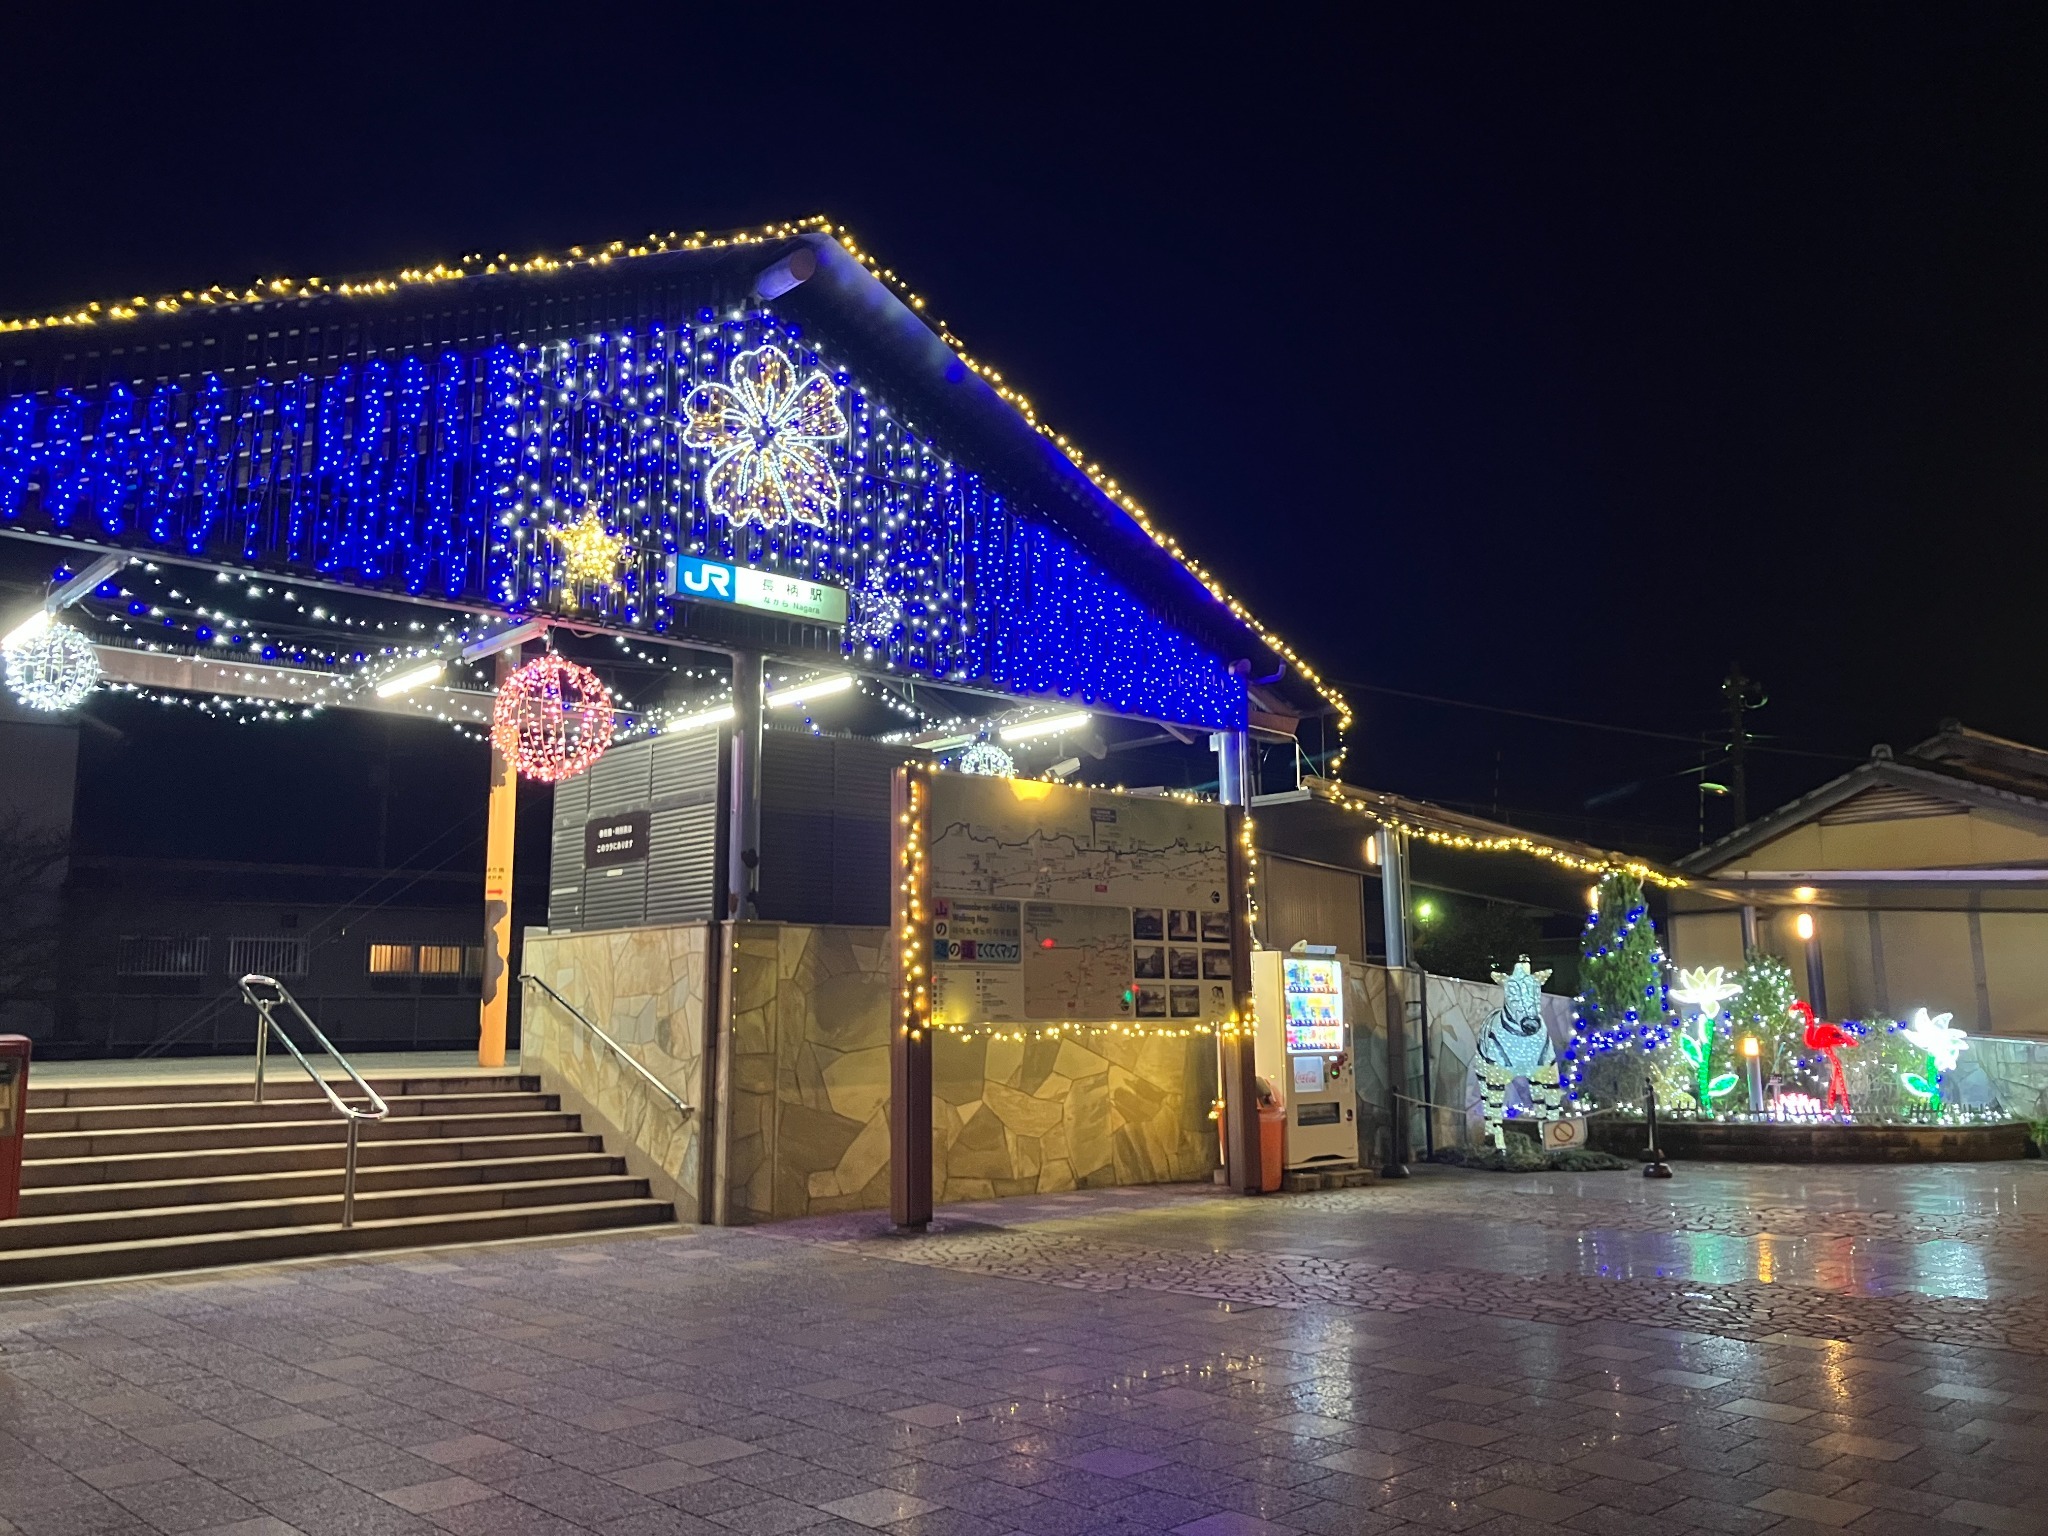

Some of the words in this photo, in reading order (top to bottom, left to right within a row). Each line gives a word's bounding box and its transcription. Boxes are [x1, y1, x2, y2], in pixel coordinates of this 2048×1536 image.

[684, 564, 730, 597] JR
[763, 579, 822, 602] 長柄駅
[793, 602, 820, 615] Nagara
[952, 913, 975, 924] Walking
[976, 914, 990, 924] Map
